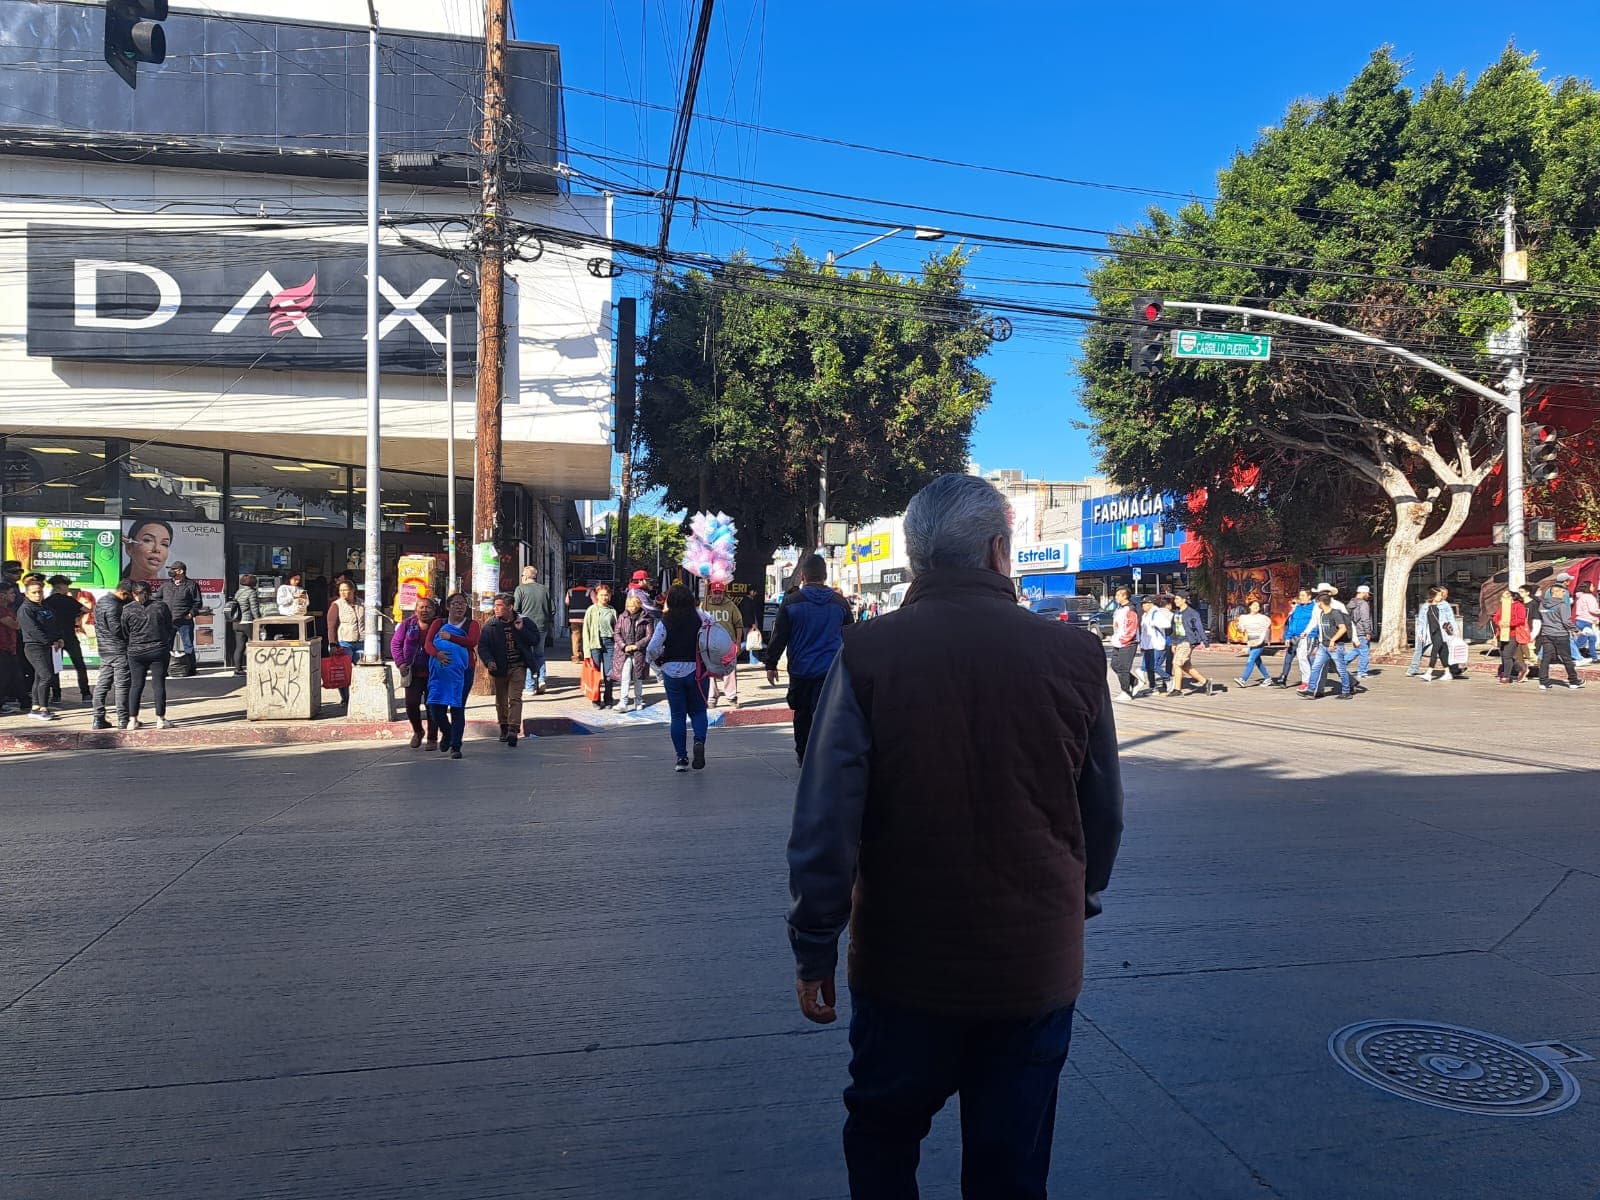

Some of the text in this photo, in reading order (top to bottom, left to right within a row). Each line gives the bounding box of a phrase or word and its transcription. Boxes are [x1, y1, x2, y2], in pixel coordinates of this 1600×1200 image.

[74, 258, 447, 344] DAX
[1196, 343, 1225, 354] CARRILLO
[1226, 344, 1250, 355] PUERTO
[1094, 494, 1163, 523] FARMACIA
[1018, 548, 1061, 562] Estrella
[255, 647, 309, 673] GREAT
